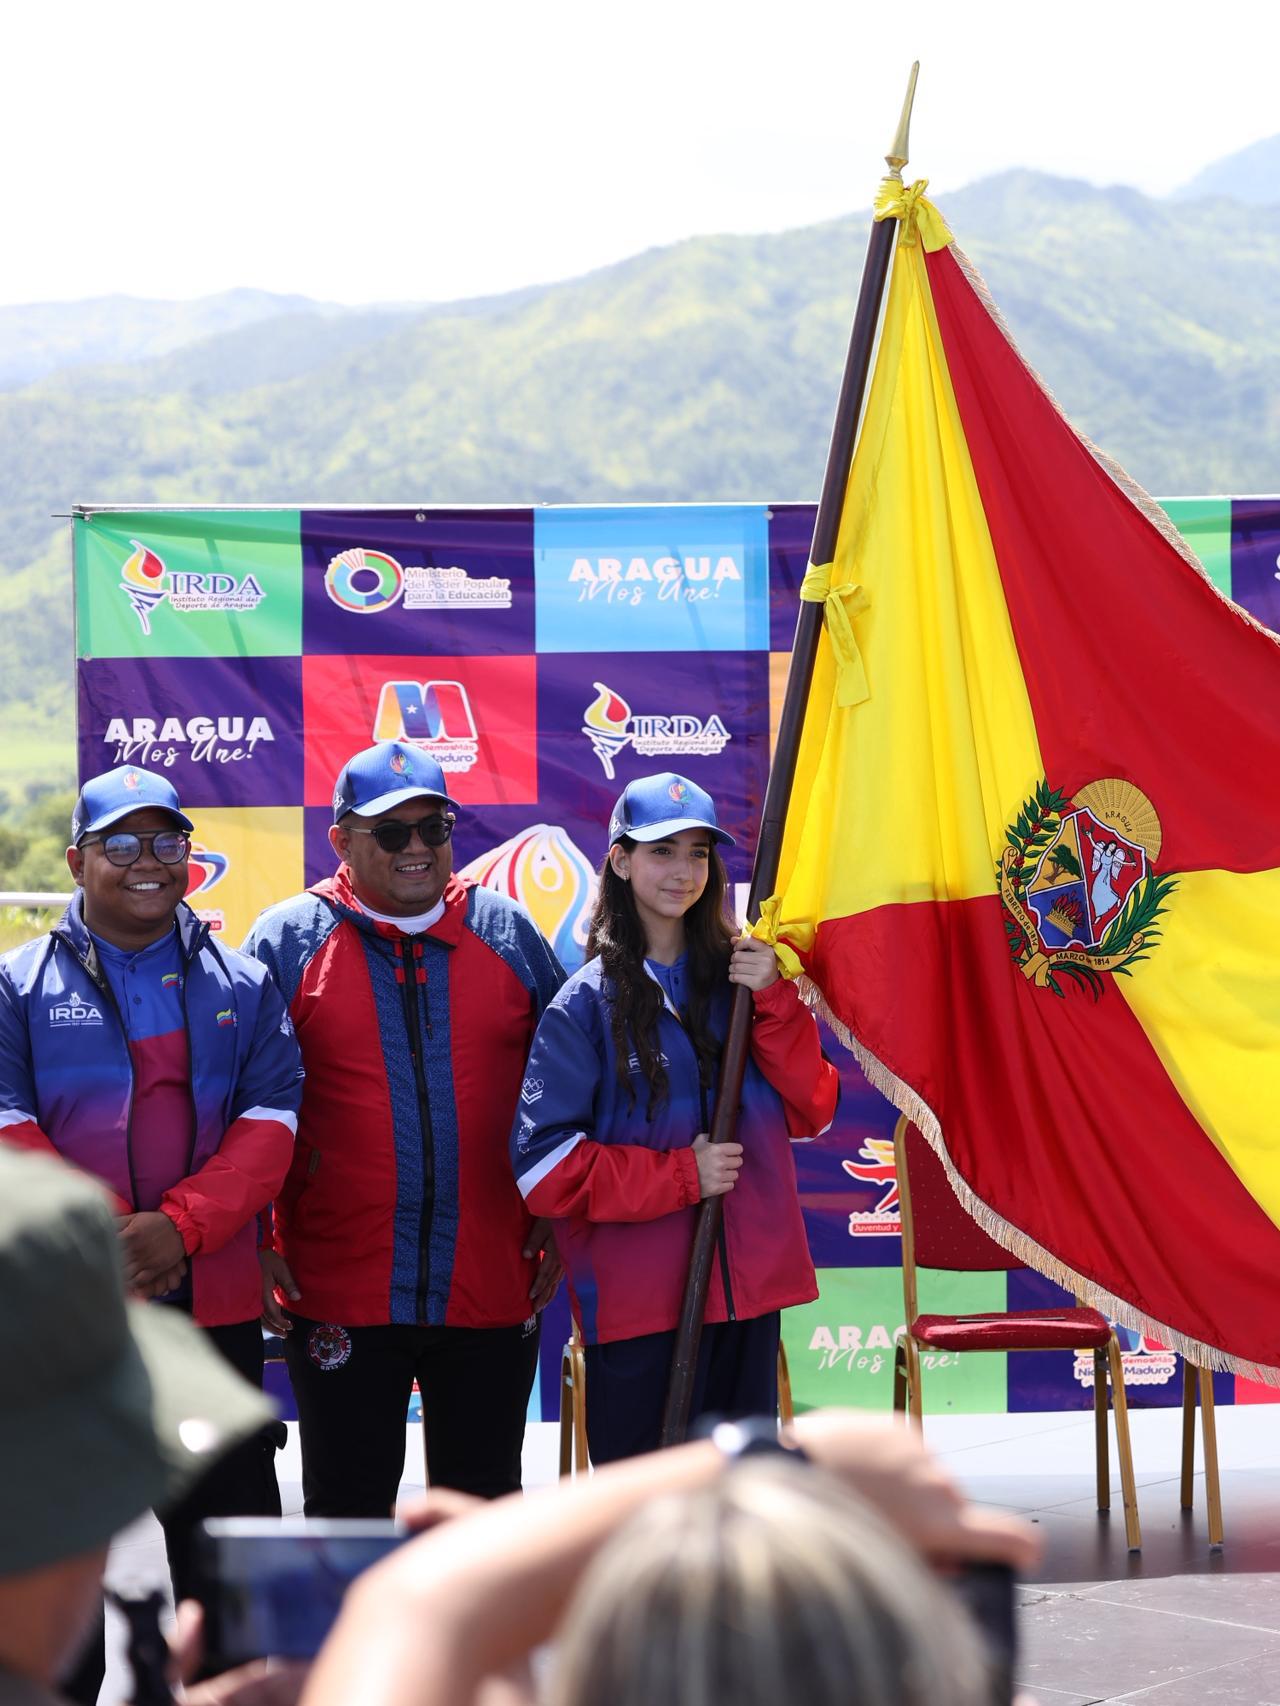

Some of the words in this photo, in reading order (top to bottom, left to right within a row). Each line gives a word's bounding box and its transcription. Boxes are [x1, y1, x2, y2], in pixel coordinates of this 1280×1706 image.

[407, 569, 464, 578] Ministerio
[568, 557, 741, 582] ARAGUA
[170, 574, 263, 595] IRDA
[407, 580, 425, 589] del
[428, 580, 460, 589] Poder
[464, 579, 508, 590] Popular
[208, 595, 243, 603] Regional
[407, 592, 432, 601] para
[435, 591, 445, 600] la
[448, 590, 509, 600] Educación
[104, 717, 275, 742] ARAGUA
[634, 716, 728, 737] IRDA
[1105, 811, 1133, 833] ARAGUA
[1003, 889, 1025, 920] FEBRERO
[1056, 952, 1085, 961] MARZO
[1094, 958, 1110, 966] 1814
[49, 1008, 103, 1021] IRDA
[854, 1224, 892, 1232] Juventud
[893, 1225, 899, 1233] y
[1124, 1366, 1171, 1375] Maduro
